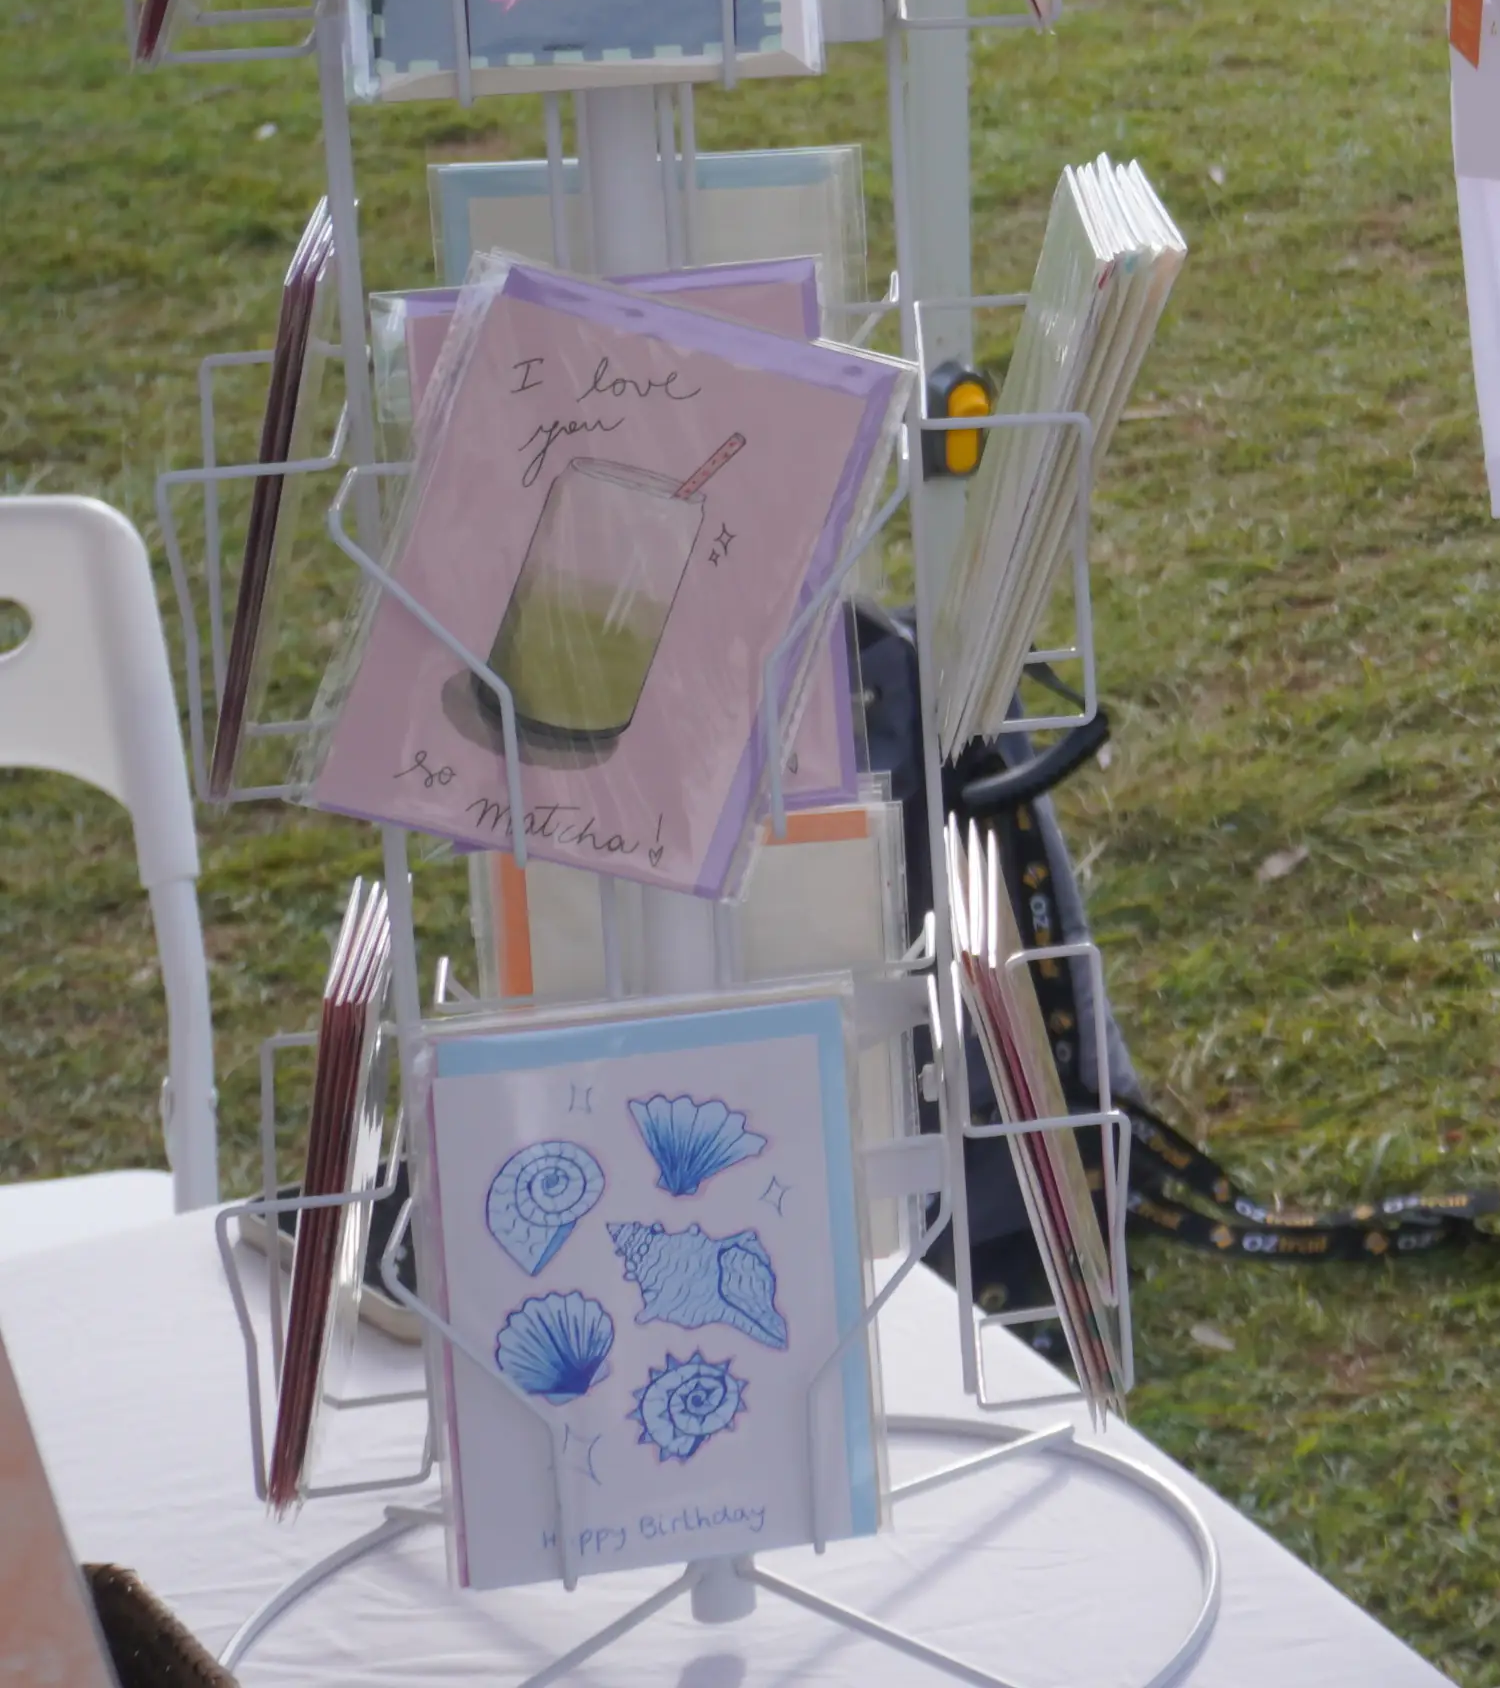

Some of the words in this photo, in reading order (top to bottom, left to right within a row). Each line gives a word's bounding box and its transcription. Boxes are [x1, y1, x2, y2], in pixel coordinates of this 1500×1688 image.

[510, 357, 545, 394] I
[575, 356, 702, 404] love
[518, 416, 626, 488] you
[542, 1527, 627, 1556] Hppy
[639, 1505, 766, 1540] Birthday
